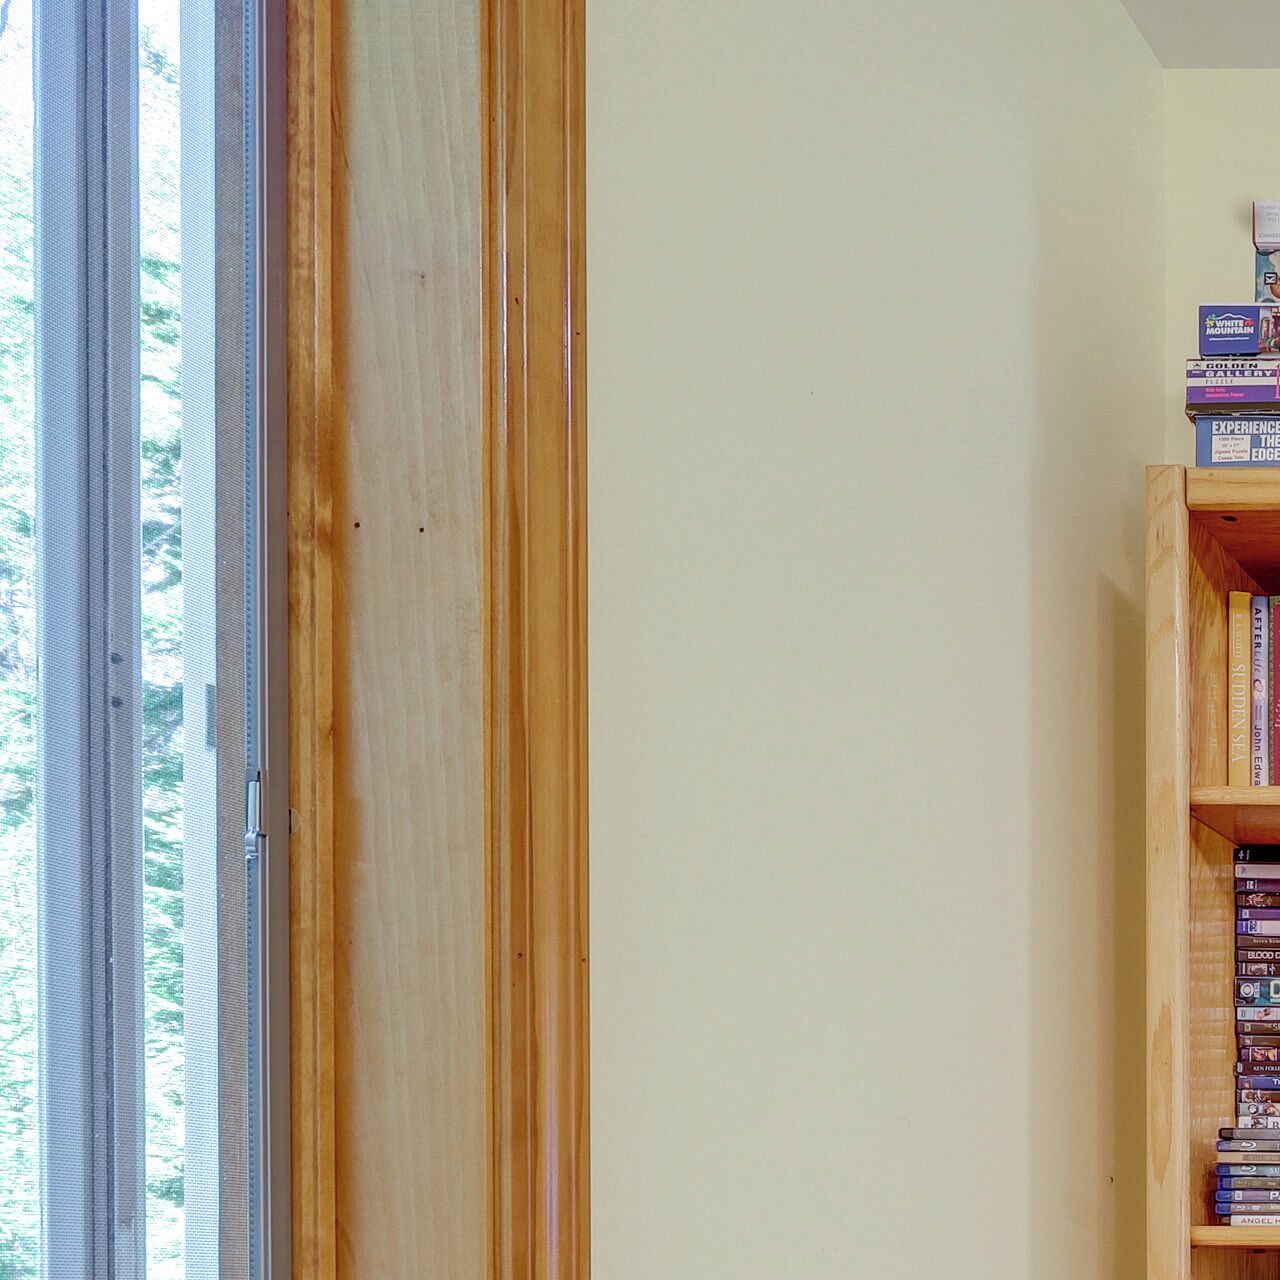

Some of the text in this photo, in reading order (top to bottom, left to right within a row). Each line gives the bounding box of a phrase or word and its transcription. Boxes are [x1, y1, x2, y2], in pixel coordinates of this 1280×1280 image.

[1206, 326, 1254, 335] MOUNTAIN
[1215, 319, 1244, 328] WHITE
[1252, 448, 1280, 462] EDGE
[1254, 607, 1262, 649] AFTER
[1232, 664, 1247, 763] SUDDEN SEA
